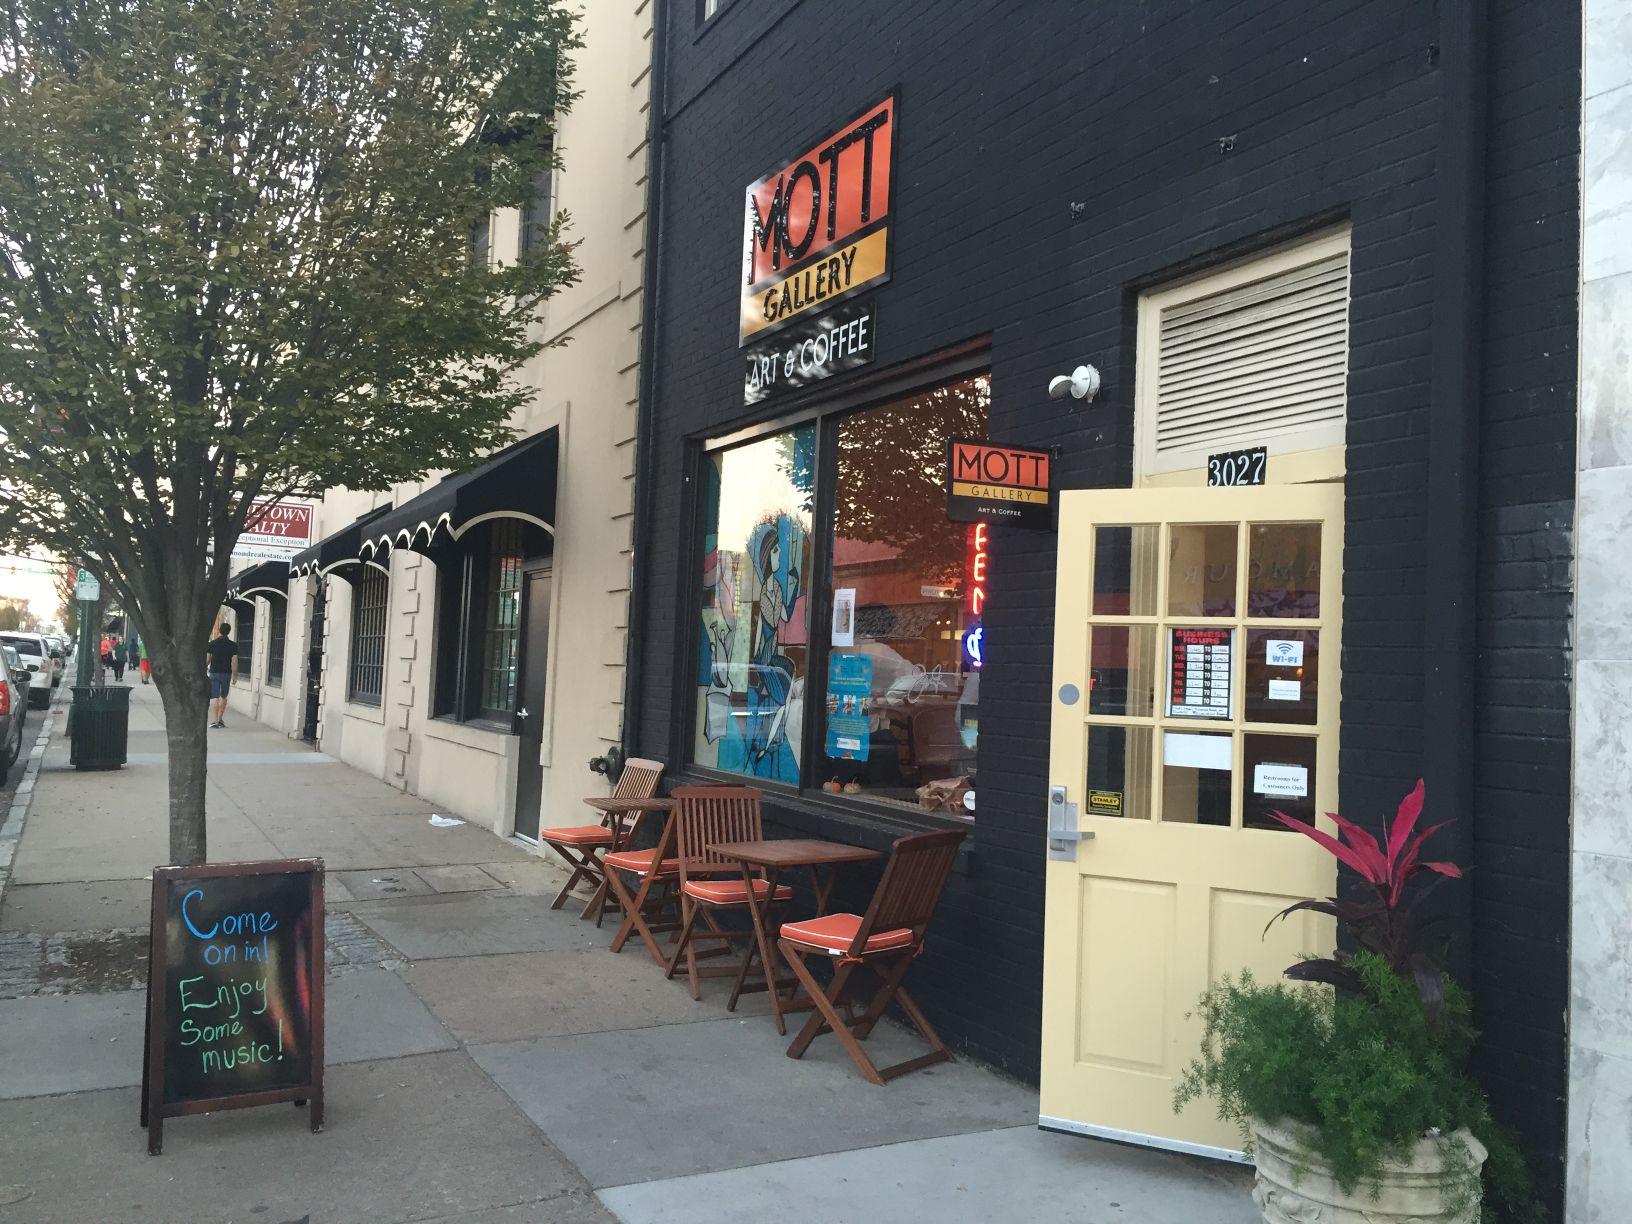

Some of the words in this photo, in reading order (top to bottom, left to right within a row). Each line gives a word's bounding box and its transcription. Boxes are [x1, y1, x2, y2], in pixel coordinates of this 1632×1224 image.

[748, 109, 888, 285] MOTT
[764, 246, 857, 322] GALLERY
[750, 353, 780, 389] ART
[784, 350, 794, 378] &
[801, 315, 869, 371] COFFEE
[959, 447, 1045, 486] MOTT
[1209, 453, 1265, 486] 3027
[971, 486, 1032, 501] GALLERY
[245, 519, 290, 535] ALTY
[247, 504, 308, 522] ETOWN
[1092, 796, 1118, 804] STANLEY
[1292, 784, 1304, 792] Only
[182, 889, 277, 940] Come
[204, 944, 236, 965] on
[179, 976, 267, 1018] Enjoy
[181, 1019, 243, 1045] Some
[203, 1019, 283, 1073] music!
